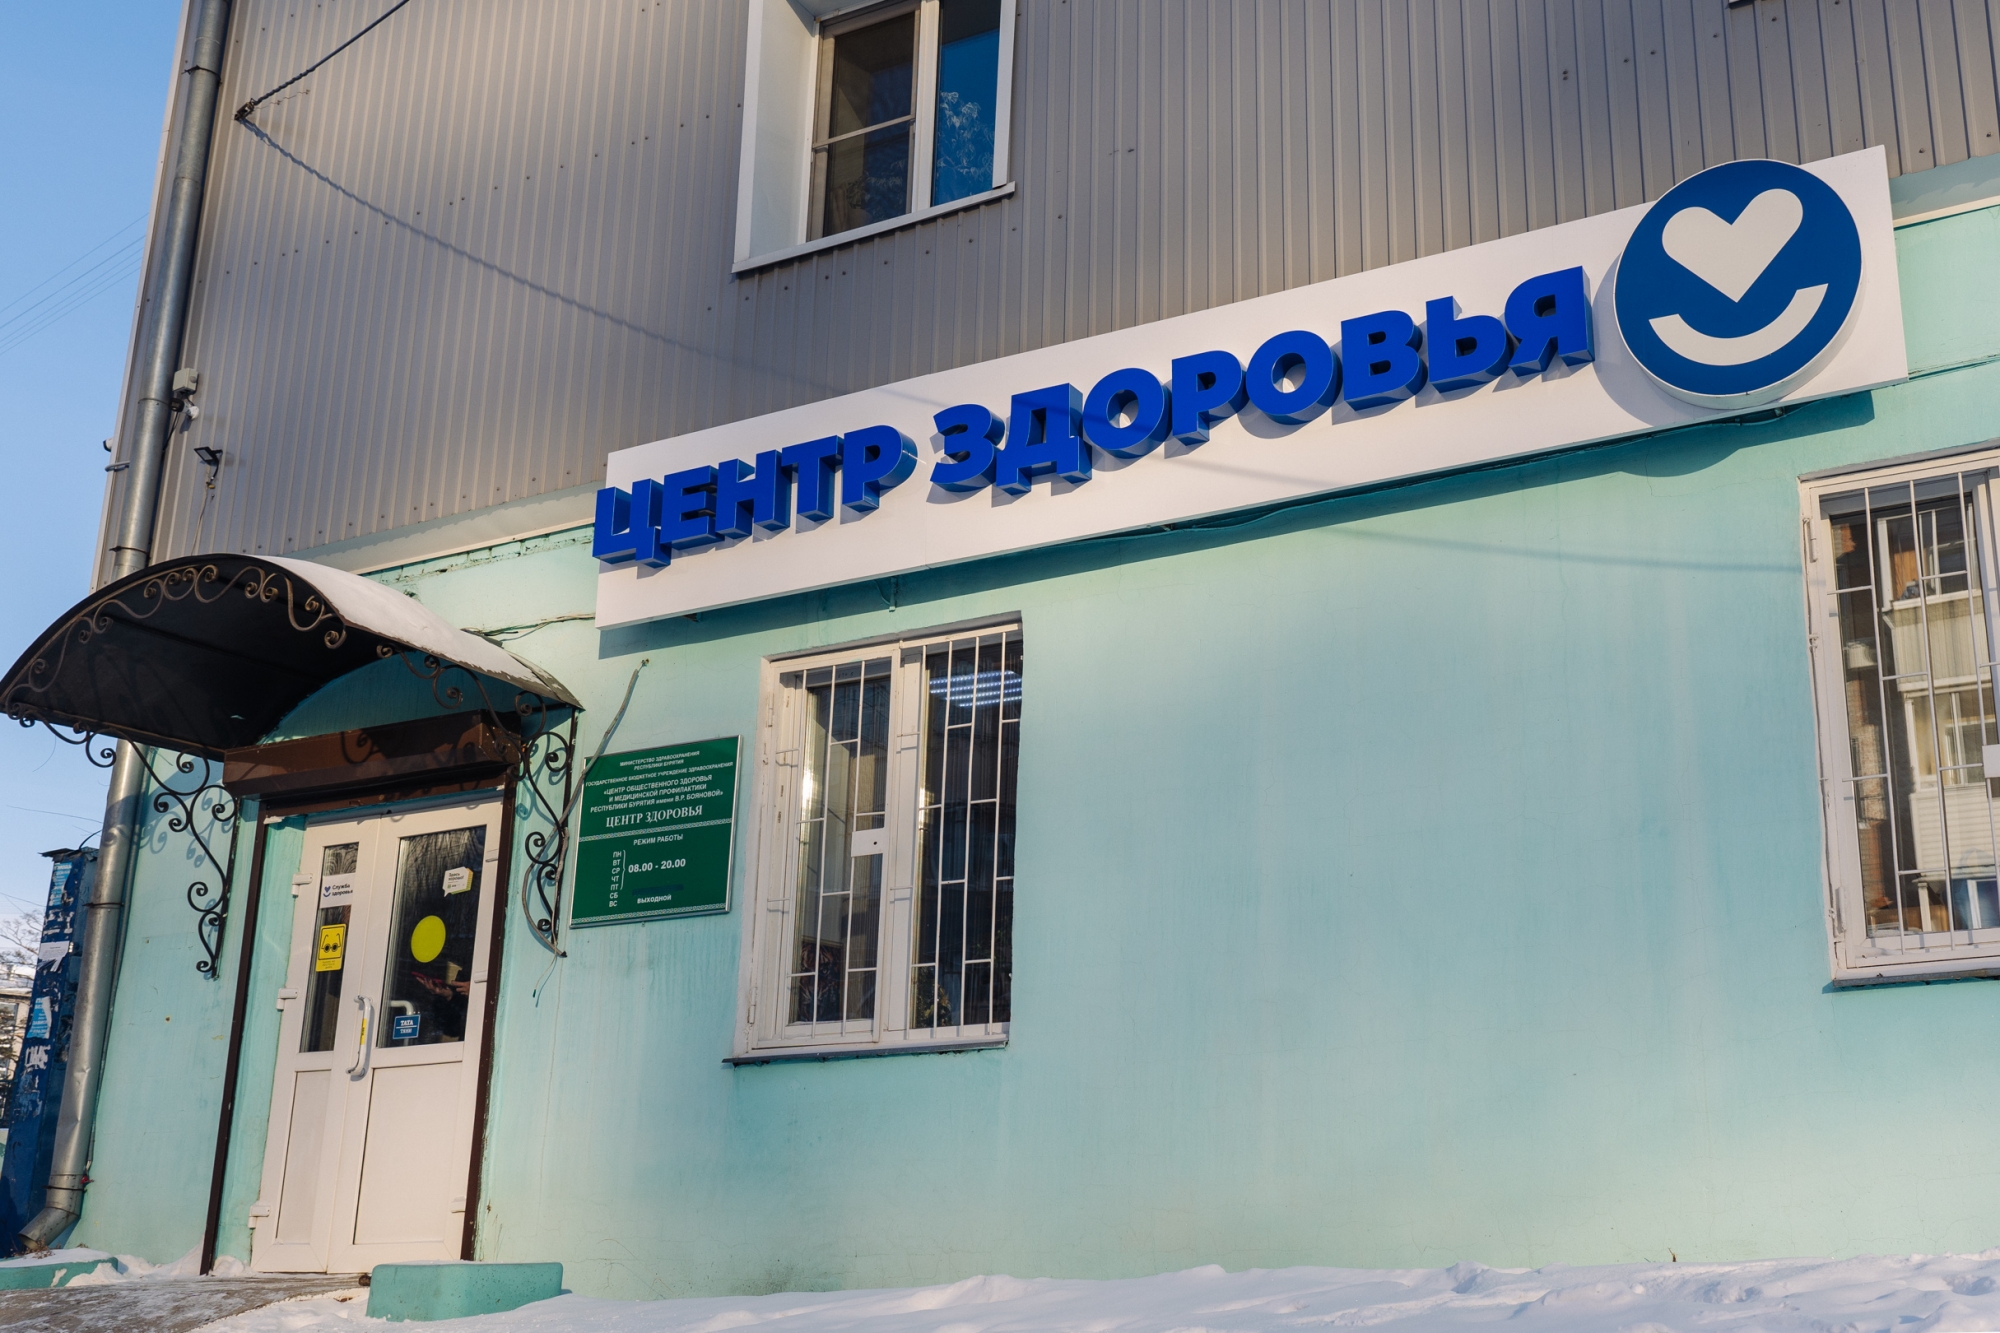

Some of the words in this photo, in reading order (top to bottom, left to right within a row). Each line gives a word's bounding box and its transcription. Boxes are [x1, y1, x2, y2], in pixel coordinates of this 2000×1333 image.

[592, 425, 914, 567] ЦЕНТР
[930, 266, 1594, 493] ЗДОРОВЬЯ
[620, 757, 655, 766] МИНИСТЕРСТВО
[656, 751, 700, 761] ЗДРАВООХРАНЕНИЯ
[634, 762, 663, 770] РЕСПУБЛИКИ
[586, 777, 628, 786] ГОСУДАРСТВЕННОЕ
[628, 772, 656, 780] БЮДЖЕТНОЕ
[658, 768, 688, 776] УЧРЕЖДЕНИЕ
[688, 762, 734, 772] ЗДРАВООХРАНЕНИЯ
[604, 786, 626, 795] «ЦЕНТР
[626, 780, 679, 792] ОБЩЕСТВЕННОГО
[680, 774, 712, 786] ЗДОРОВЬЯ
[614, 789, 658, 802] МЕДИЦИНСКОЙ
[659, 784, 707, 796] ПРОФИЛАКТИКИ
[590, 802, 628, 813] РЕСПУБЛИКИ
[628, 798, 655, 808] БУРЯТИЯ
[686, 788, 724, 800] БОЯНОВОЙ»
[606, 812, 643, 828] ЦЕНТР
[645, 804, 703, 823] ЗДОРОВЬЯ
[633, 836, 656, 846] РЕЖИМ
[656, 834, 684, 842] РАБОТЫ
[628, 862, 653, 873] 08.00
[660, 858, 686, 870] 20.00
